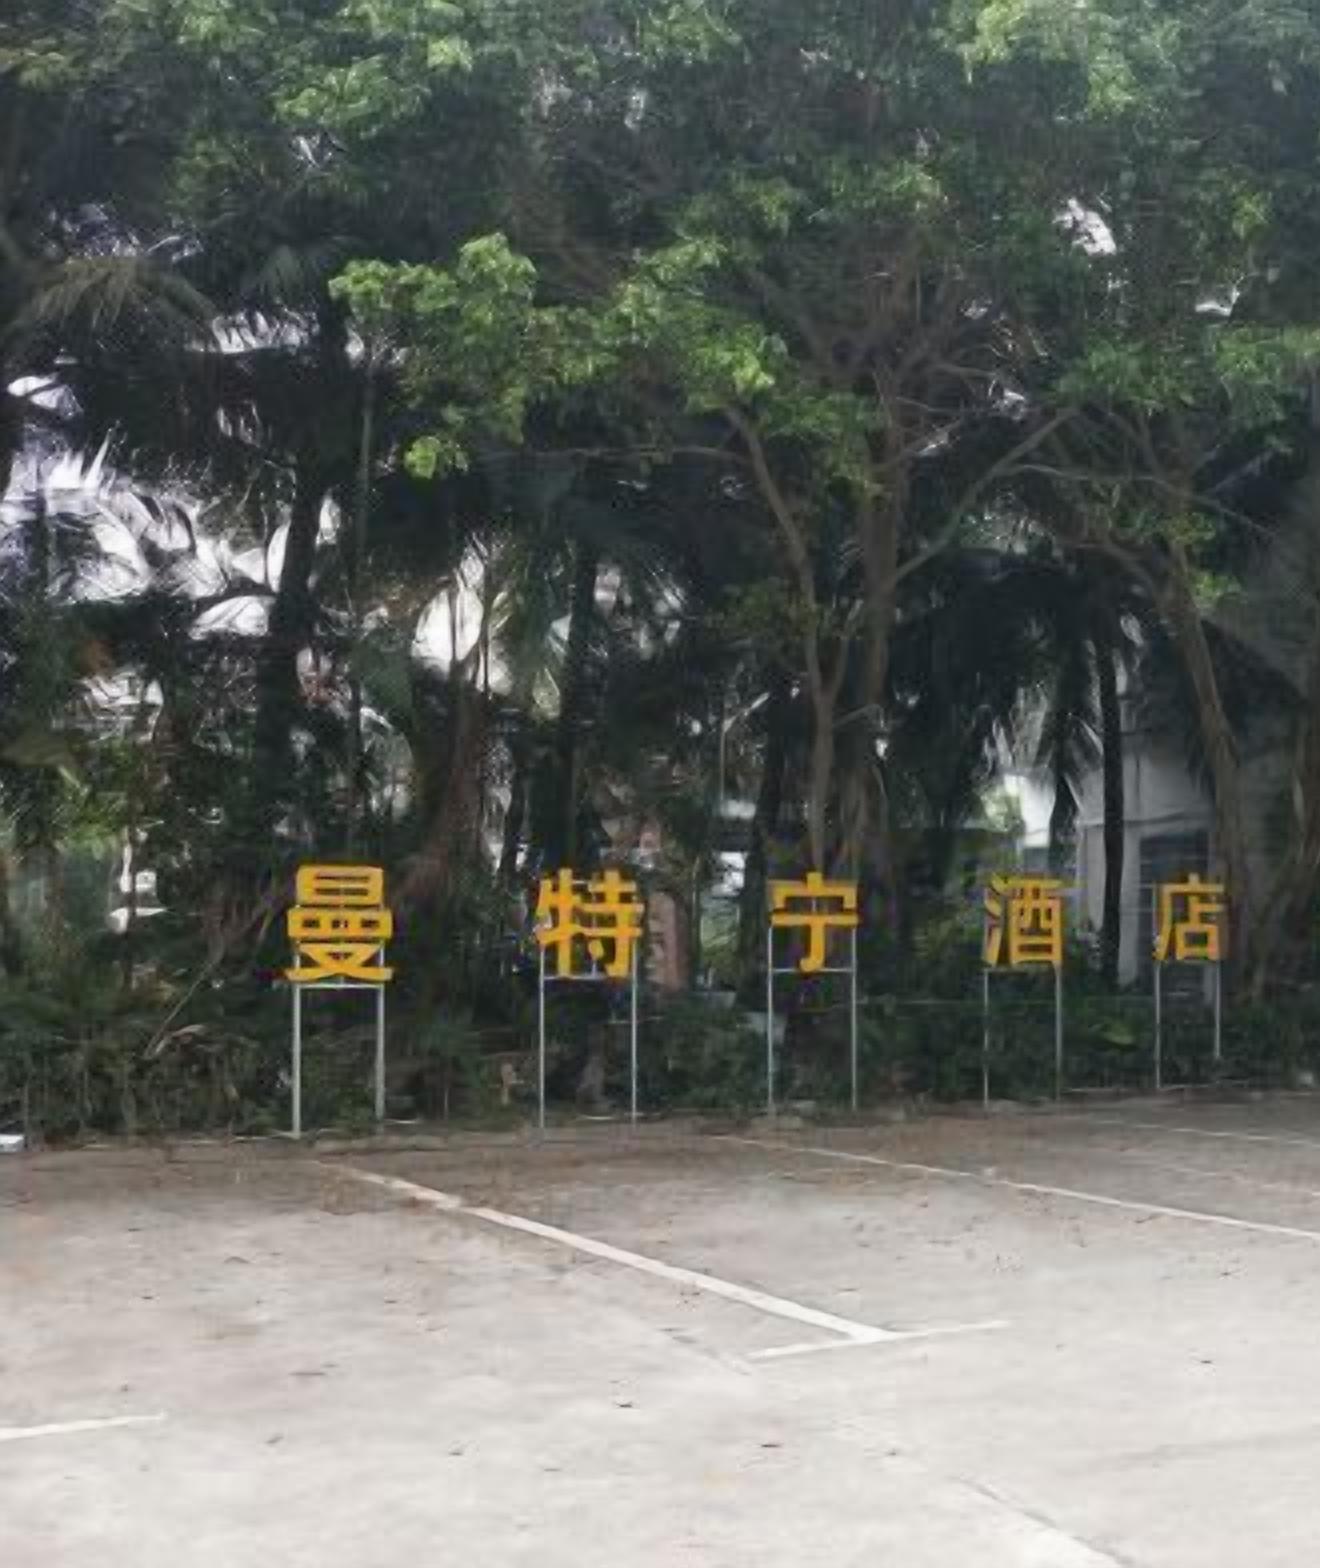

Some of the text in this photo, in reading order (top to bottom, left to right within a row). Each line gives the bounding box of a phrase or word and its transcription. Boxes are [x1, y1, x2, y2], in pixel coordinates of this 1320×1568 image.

[286, 865, 1225, 982] 曼特宁酒店
